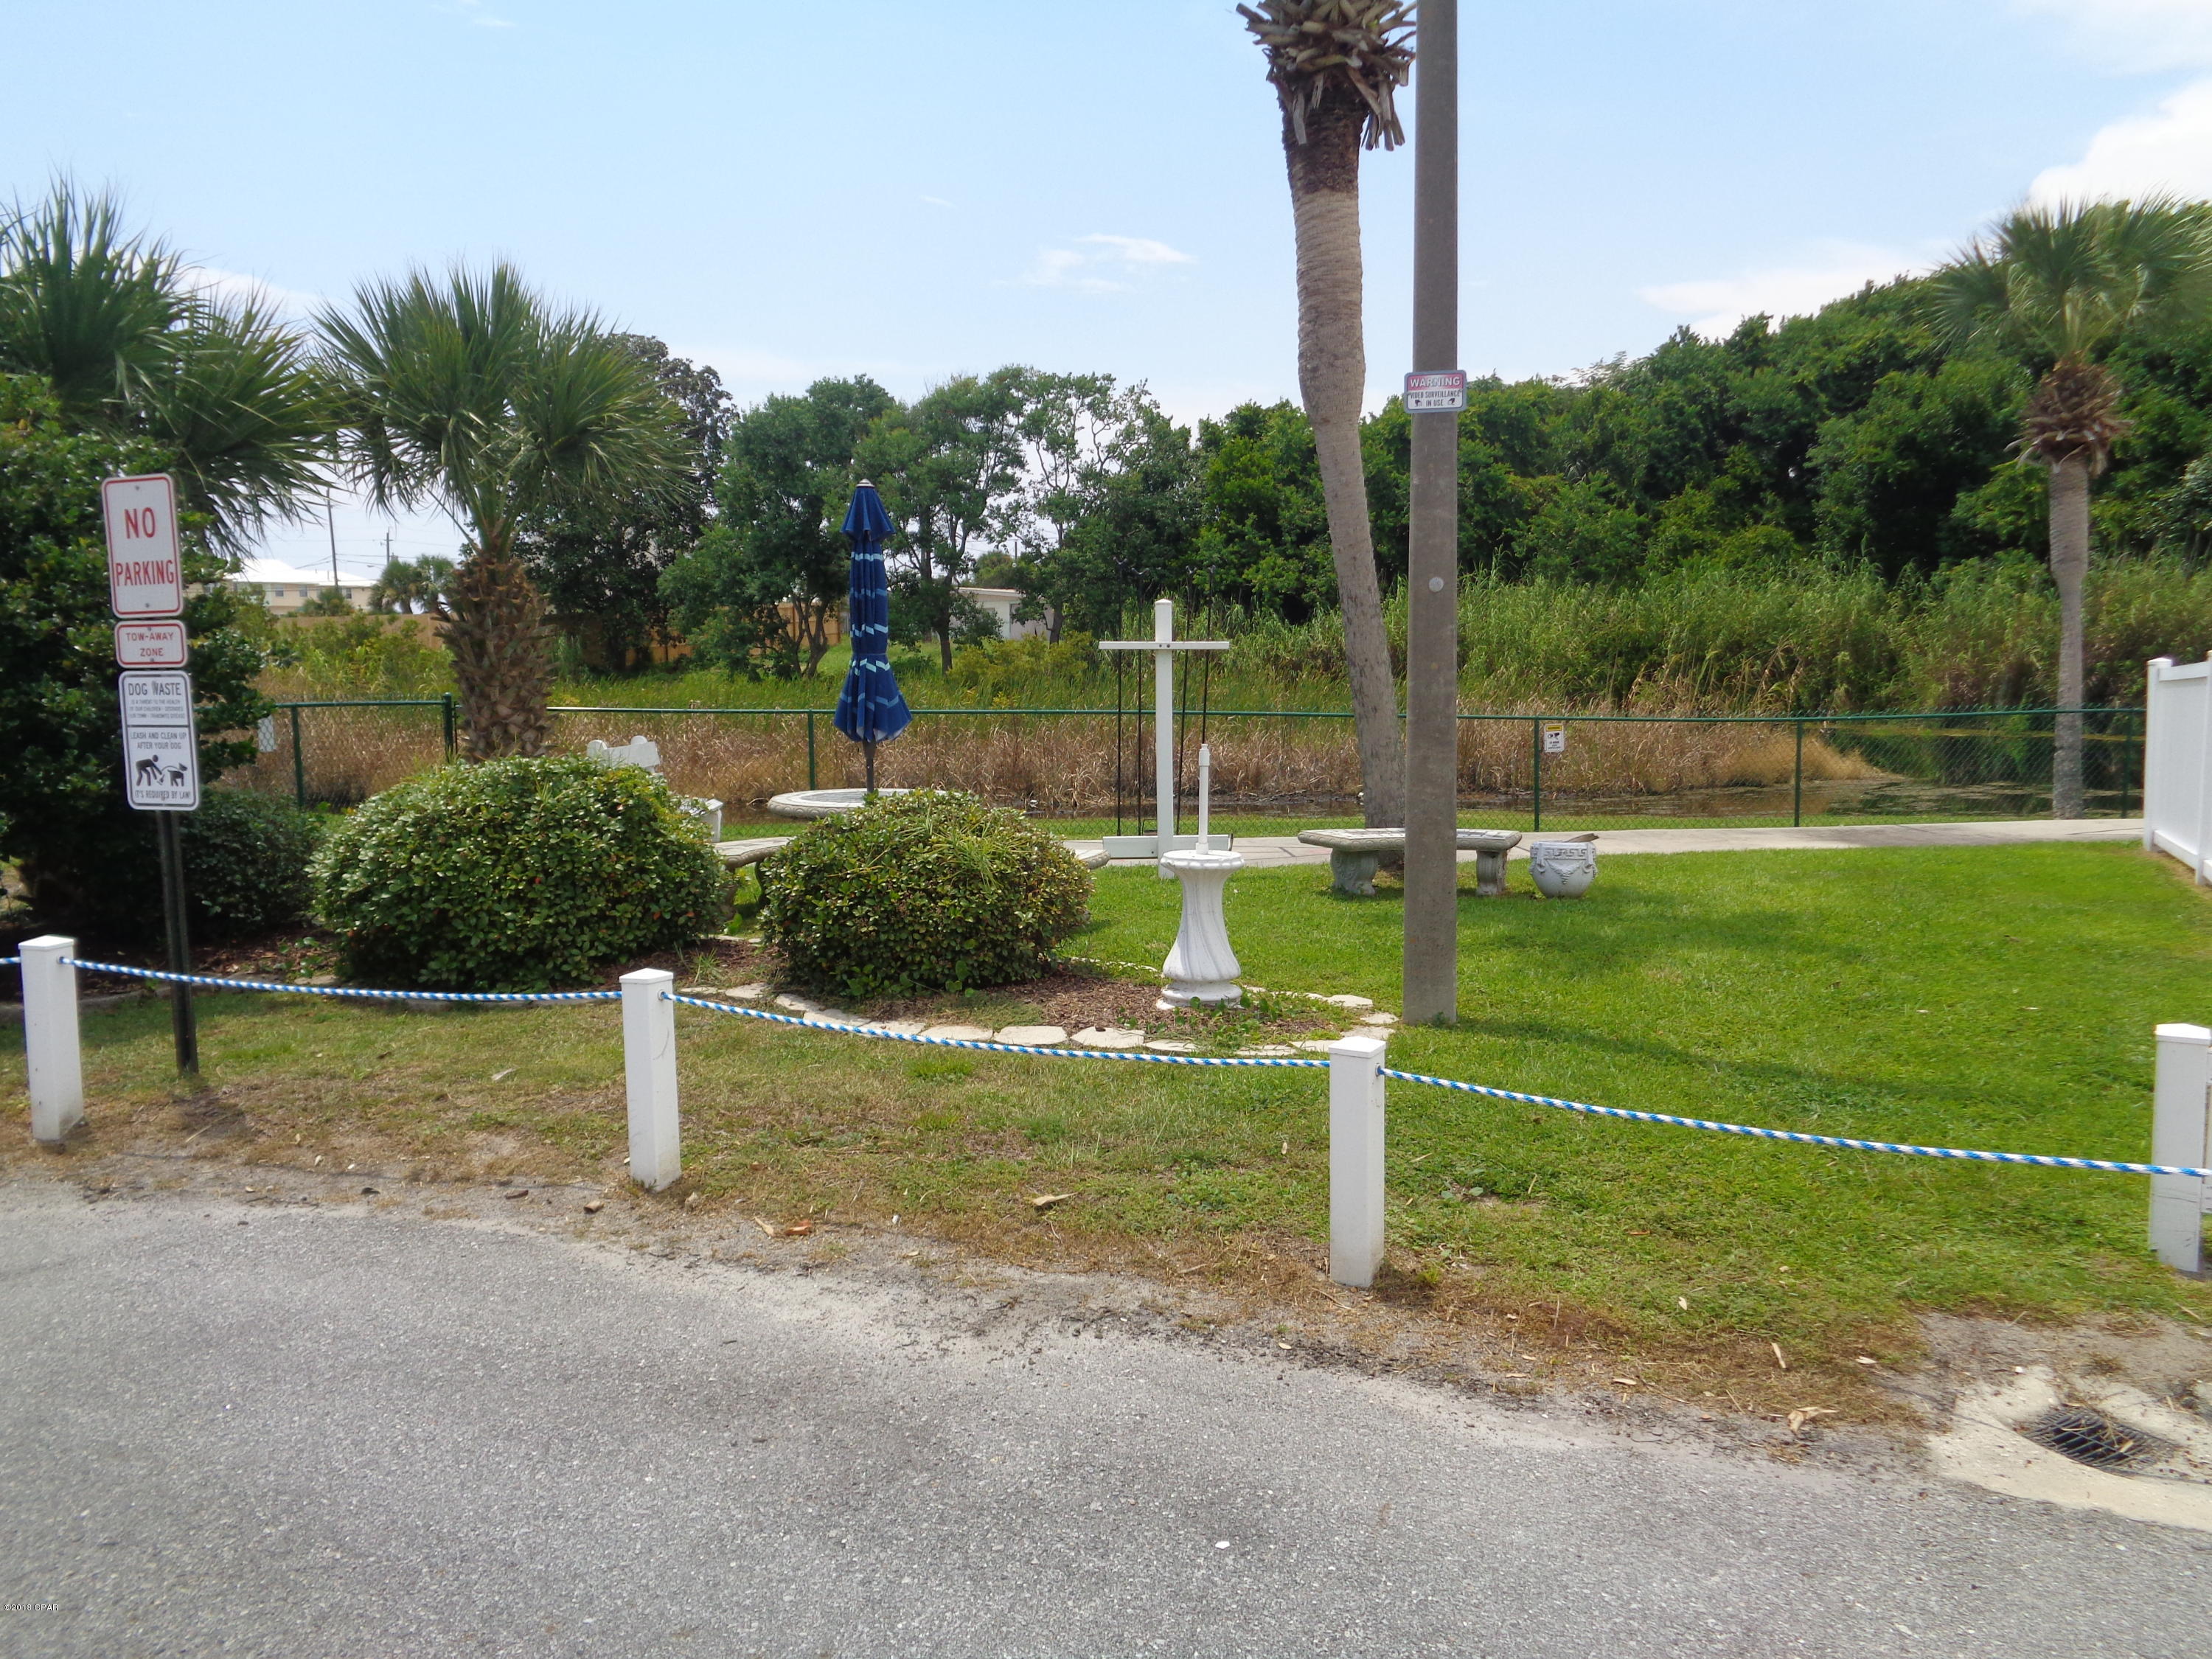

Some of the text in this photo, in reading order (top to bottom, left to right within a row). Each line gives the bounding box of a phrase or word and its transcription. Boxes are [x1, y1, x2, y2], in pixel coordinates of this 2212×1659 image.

[1410, 377, 1460, 388] WARNING
[1411, 389, 1460, 399] VIDEO SURVEILLANCE
[124, 507, 156, 539] NO
[116, 560, 175, 586] PARKING
[126, 632, 174, 641] TOW-AWAY
[140, 648, 164, 657] ZONE
[128, 682, 181, 695] DOG WASTE
[161, 731, 178, 740] CLEAN
[146, 790, 169, 799] REQUIRED
